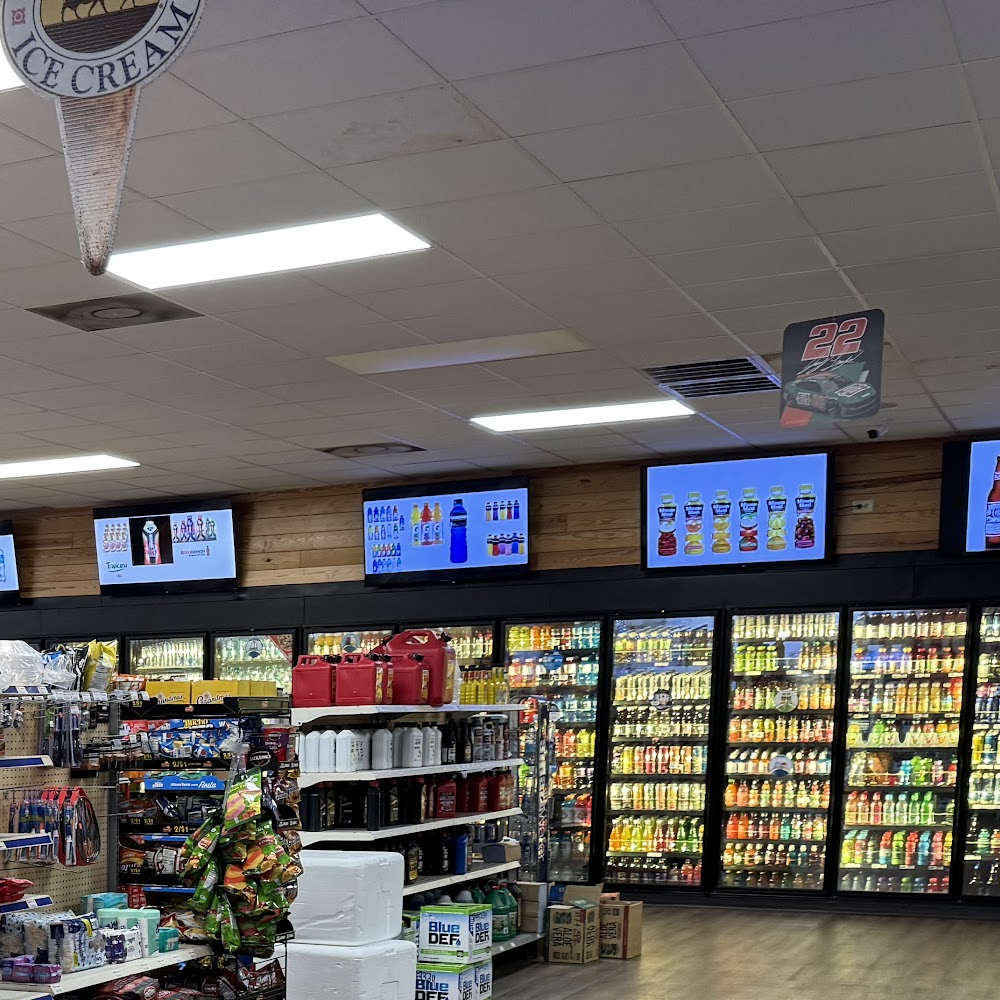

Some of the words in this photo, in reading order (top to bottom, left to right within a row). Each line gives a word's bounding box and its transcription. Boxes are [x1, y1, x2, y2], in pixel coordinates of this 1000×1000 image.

[11, 31, 65, 88] ICE
[71, 1, 193, 94] CREAM
[801, 318, 868, 361] 22
[174, 825, 189, 833] 2/$1
[429, 921, 460, 933] Blue
[475, 922, 489, 932] Blue
[429, 932, 460, 945] DEF
[475, 931, 489, 944] DEF
[552, 926, 563, 947] VERA
[562, 926, 572, 947] ALOE
[463, 979, 472, 990] Blue
[480, 973, 490, 984] Blue
[416, 979, 449, 991] Blue
[480, 981, 490, 994] DEF
[463, 989, 472, 1000] DEF
